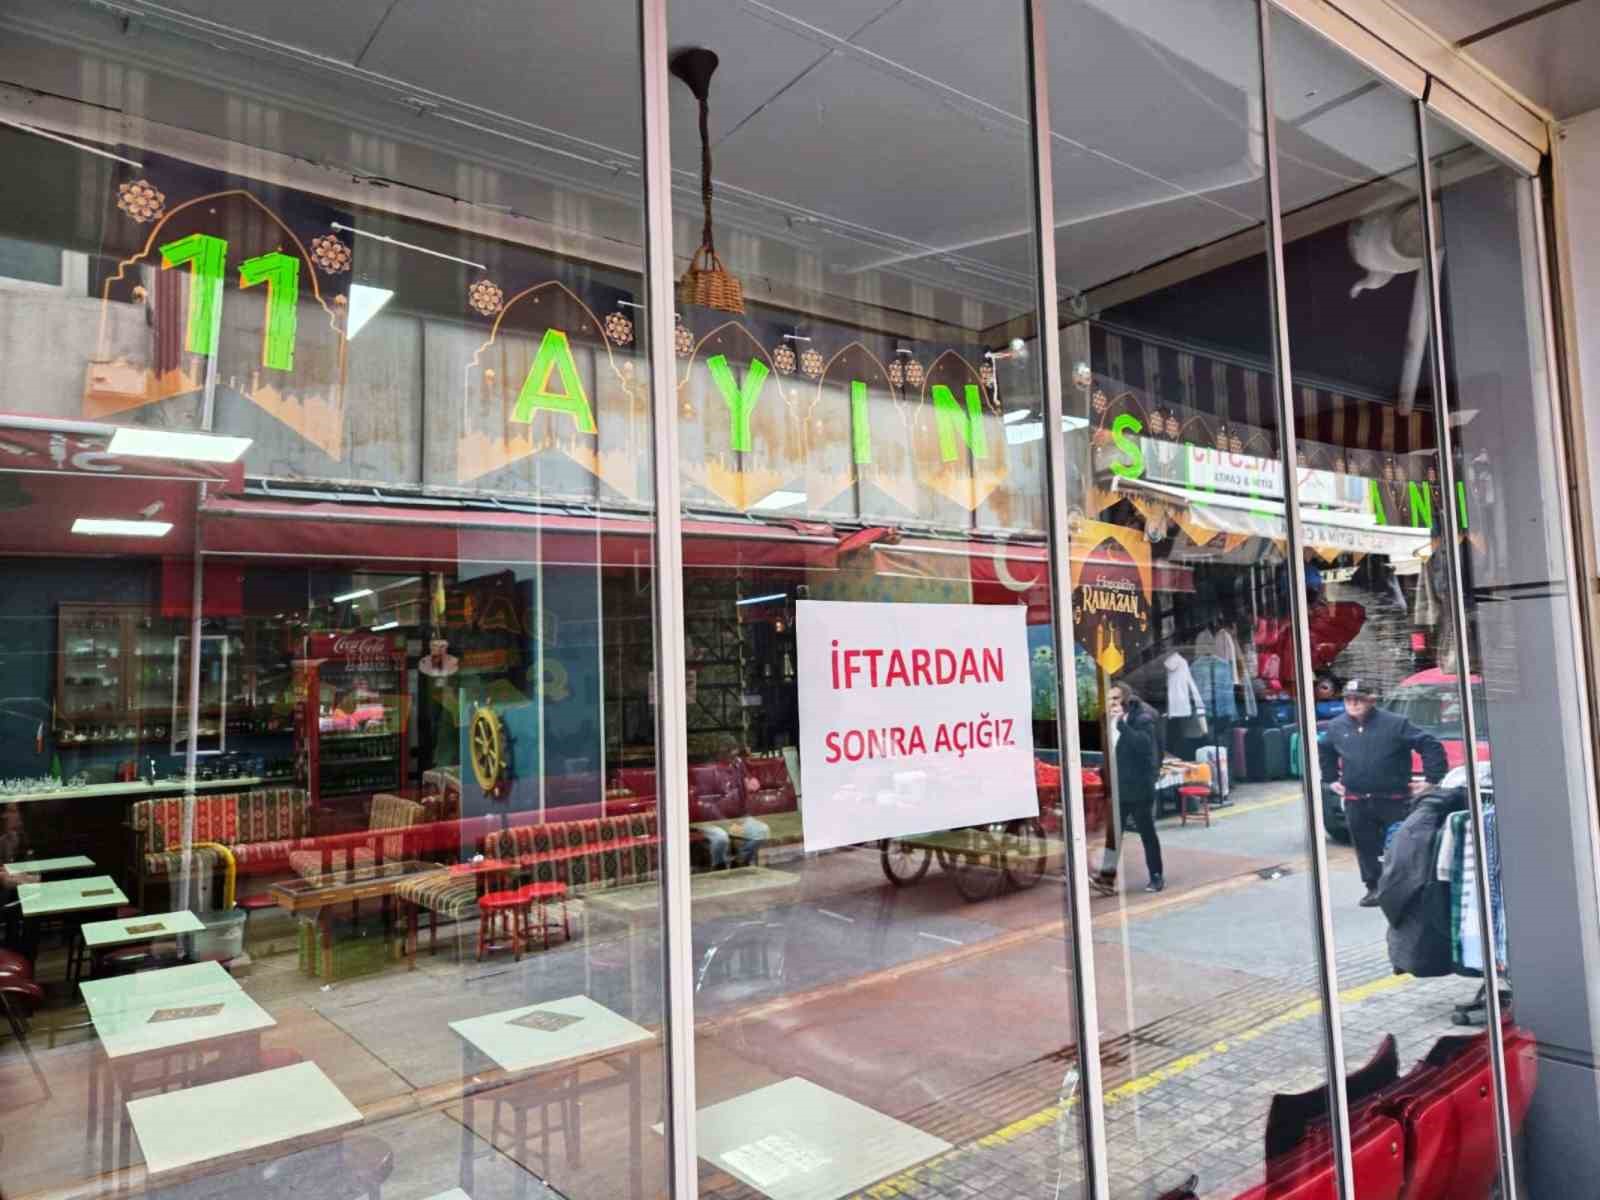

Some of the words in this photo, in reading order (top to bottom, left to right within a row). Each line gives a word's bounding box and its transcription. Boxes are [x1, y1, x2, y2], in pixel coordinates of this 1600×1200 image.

[160, 233, 300, 371] 11
[1083, 584, 1139, 618] RAMAZAN
[831, 639, 1004, 689] İFTARDAN
[825, 724, 927, 763] SONRA
[934, 712, 1016, 758] AÇIĞIZ
